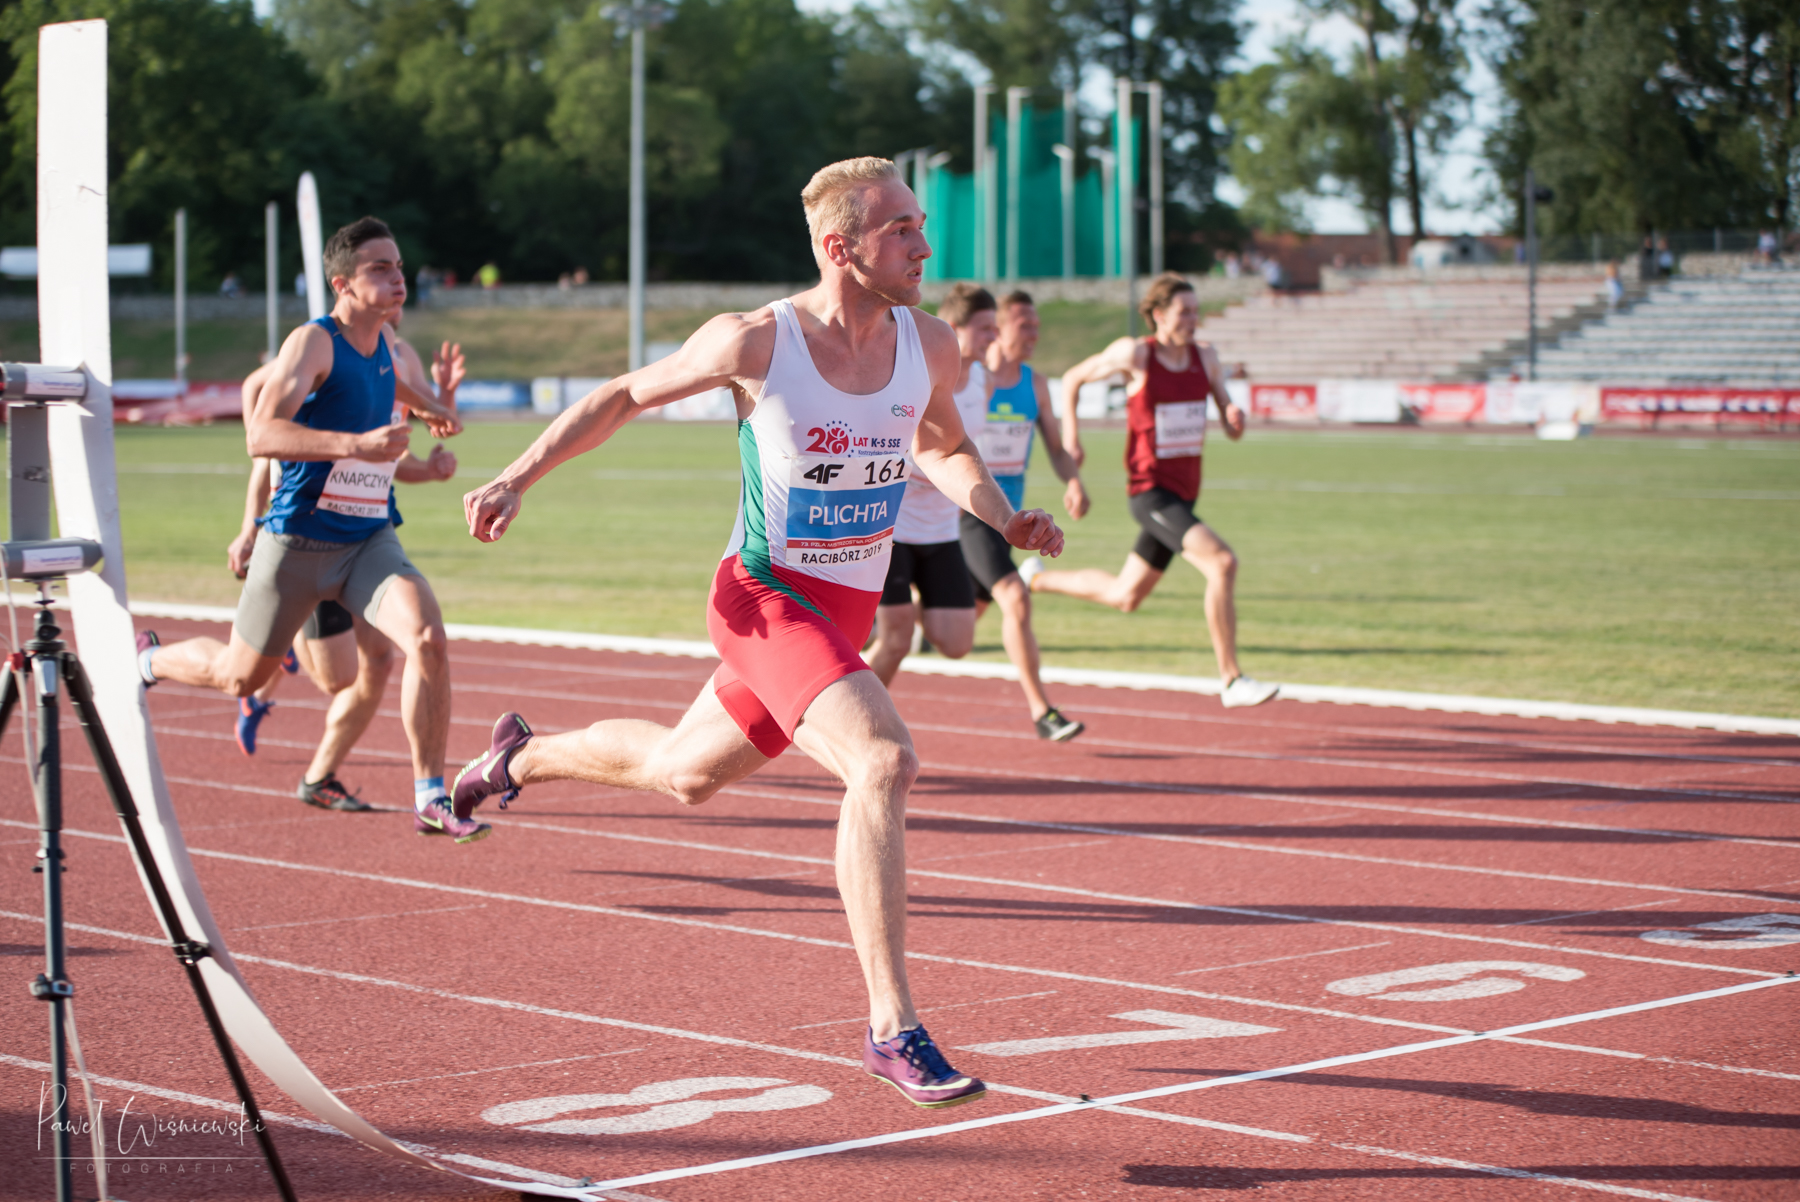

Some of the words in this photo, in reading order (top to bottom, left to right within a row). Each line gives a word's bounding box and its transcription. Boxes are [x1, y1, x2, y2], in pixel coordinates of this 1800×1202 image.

[890, 404, 915, 417] esa
[853, 437, 868, 447] LAT
[871, 438, 886, 448] K-S
[887, 438, 901, 448] SSE
[330, 471, 391, 488] KNAPCZYK
[803, 463, 844, 484] 4F
[864, 458, 906, 485] 161
[327, 502, 366, 515] RACIBÓRZ
[367, 507, 380, 515] 2019
[808, 501, 887, 526] PLICHTA
[801, 549, 860, 564] RACIBÓRZ
[863, 543, 882, 559] 2019
